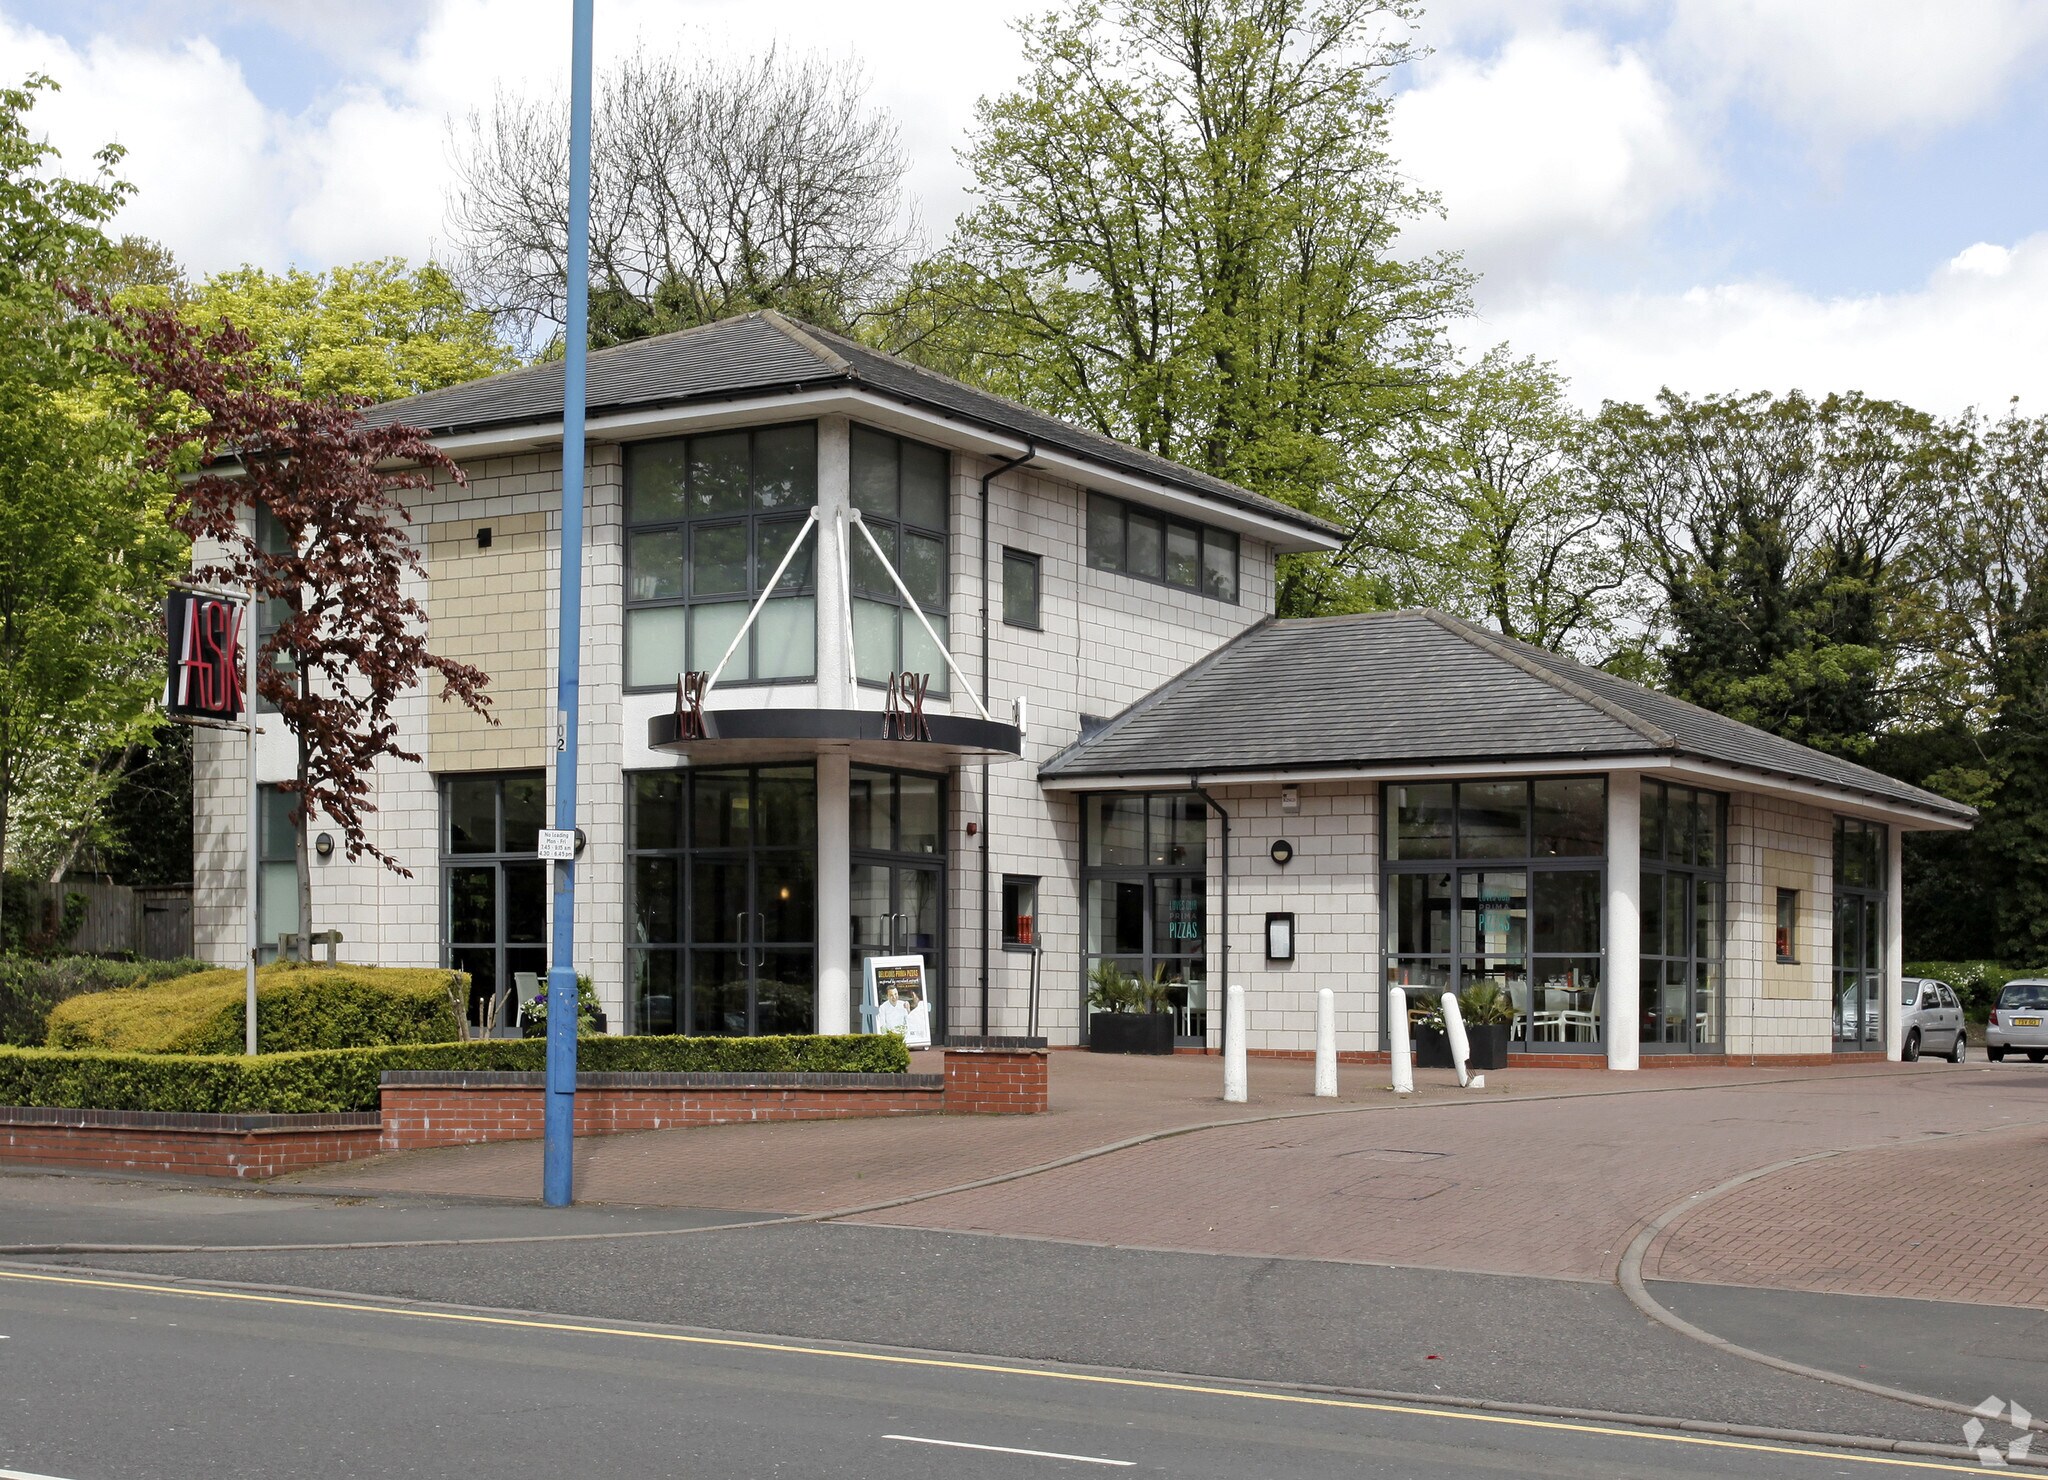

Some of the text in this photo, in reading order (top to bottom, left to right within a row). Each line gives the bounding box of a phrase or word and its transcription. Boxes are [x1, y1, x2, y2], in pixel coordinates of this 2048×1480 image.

[178, 598, 245, 713] ASK
[675, 671, 710, 739] ASK
[882, 671, 932, 741] ASK
[1169, 900, 1185, 910] LOVES
[1479, 913, 1510, 931] PIZZAS
[1169, 921, 1197, 939] PIZZAS
